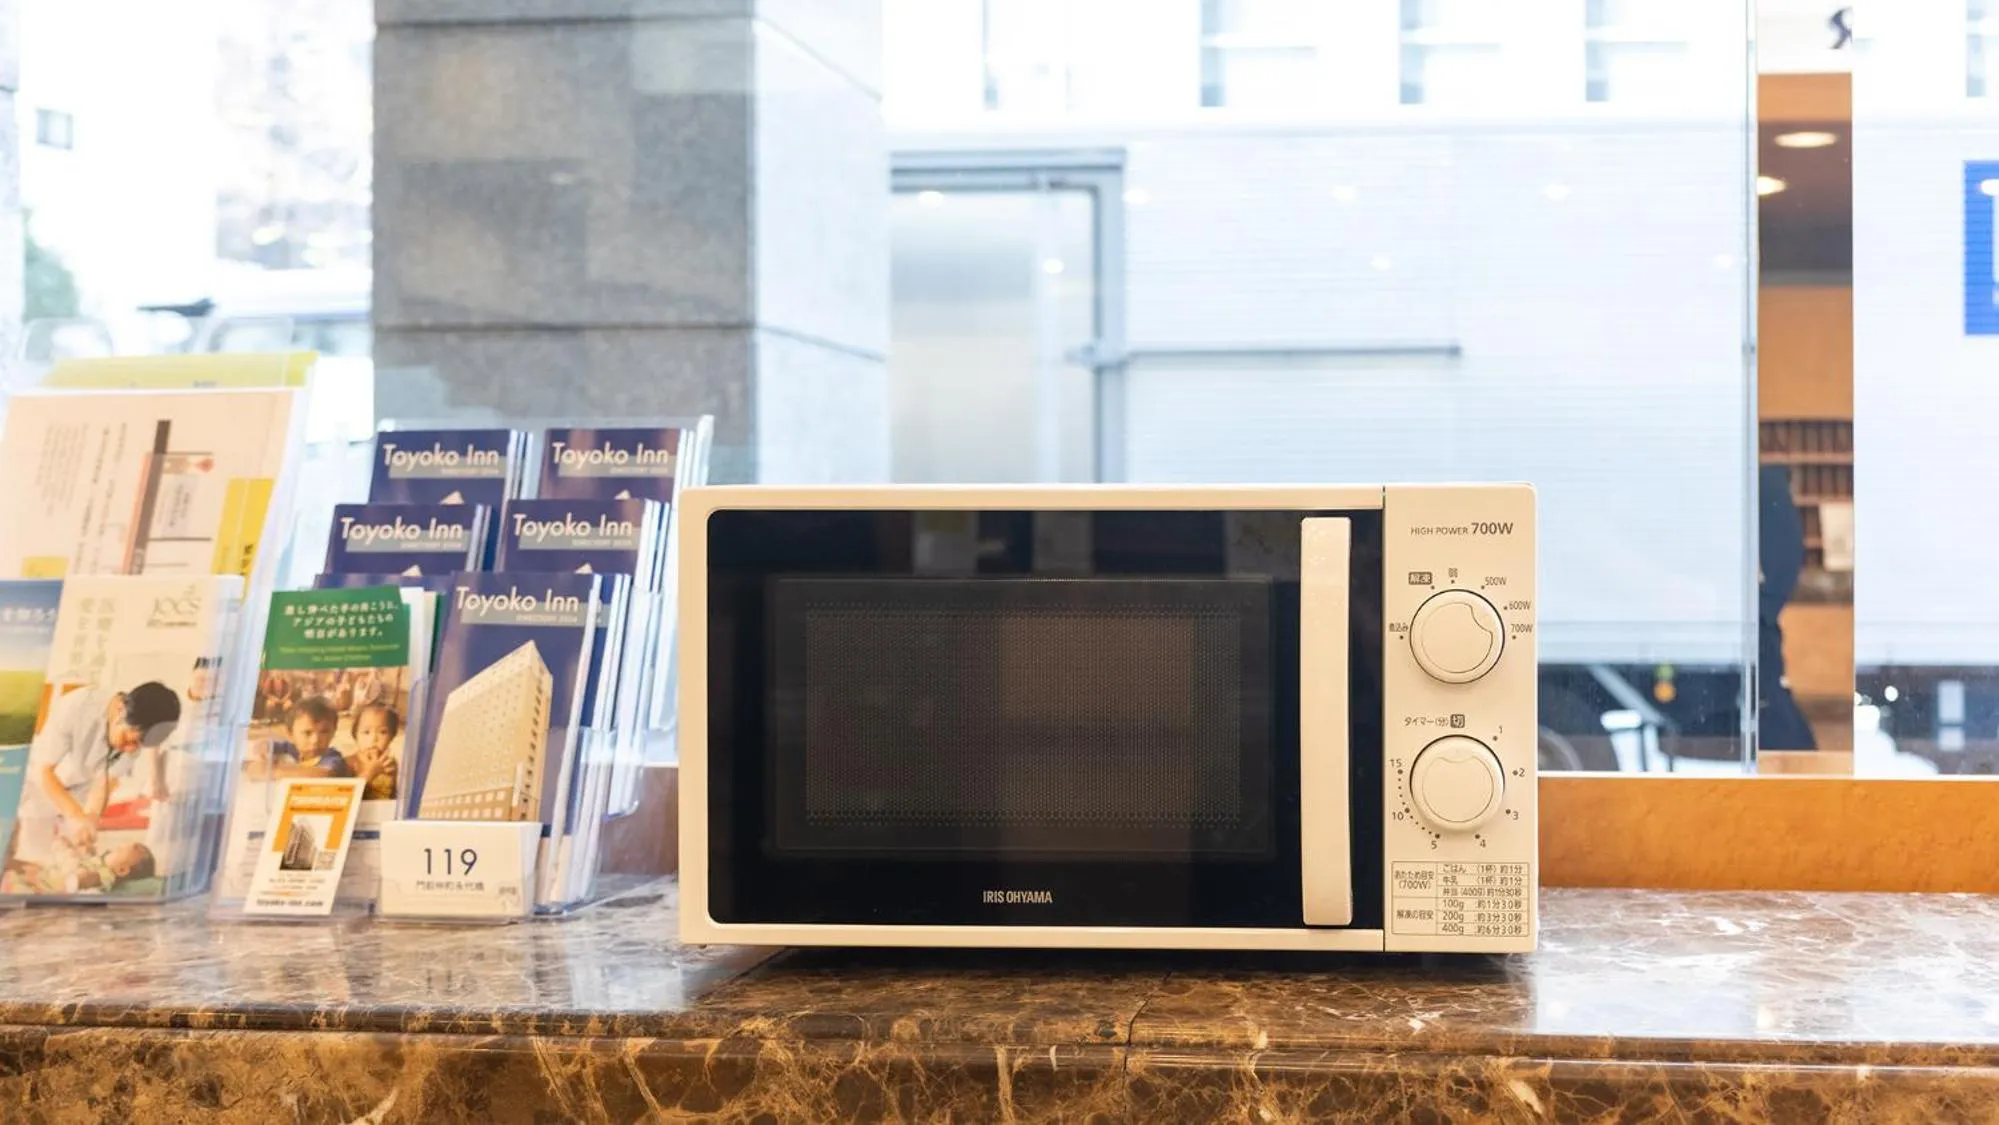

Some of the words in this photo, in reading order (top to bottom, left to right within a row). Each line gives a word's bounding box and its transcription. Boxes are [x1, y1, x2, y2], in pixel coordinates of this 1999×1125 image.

[382, 442, 458, 469] Toyoko
[466, 444, 500, 466] Inn
[552, 442, 628, 469] Toyoko
[636, 443, 668, 464] Inn
[340, 515, 421, 541] Toyoko
[429, 518, 463, 539] Inn
[512, 513, 591, 538] Toyoko
[599, 515, 633, 537] Inn
[1411, 526, 1433, 535] HIGH
[1436, 526, 1468, 535] POWER
[1471, 522, 1513, 535] 700W
[1485, 576, 1507, 586] 500W
[456, 585, 536, 612] Toyoko
[545, 588, 579, 612] Inn
[1509, 600, 1531, 610] 600W
[1511, 623, 1533, 633] 700W
[1498, 725, 1503, 734] 1
[1390, 759, 1402, 768] 15
[1518, 768, 1525, 777] 2
[1392, 811, 1404, 821] 10
[1512, 811, 1519, 820] 3
[1431, 840, 1437, 849] 5
[1480, 840, 1486, 849] 4
[424, 848, 477, 875] 119
[983, 891, 1004, 903] IRIS
[1006, 891, 1053, 903] OHYAMA
[1443, 899, 1464, 911] 100g
[1443, 911, 1464, 923] 200g
[1442, 923, 1464, 935] 400g
